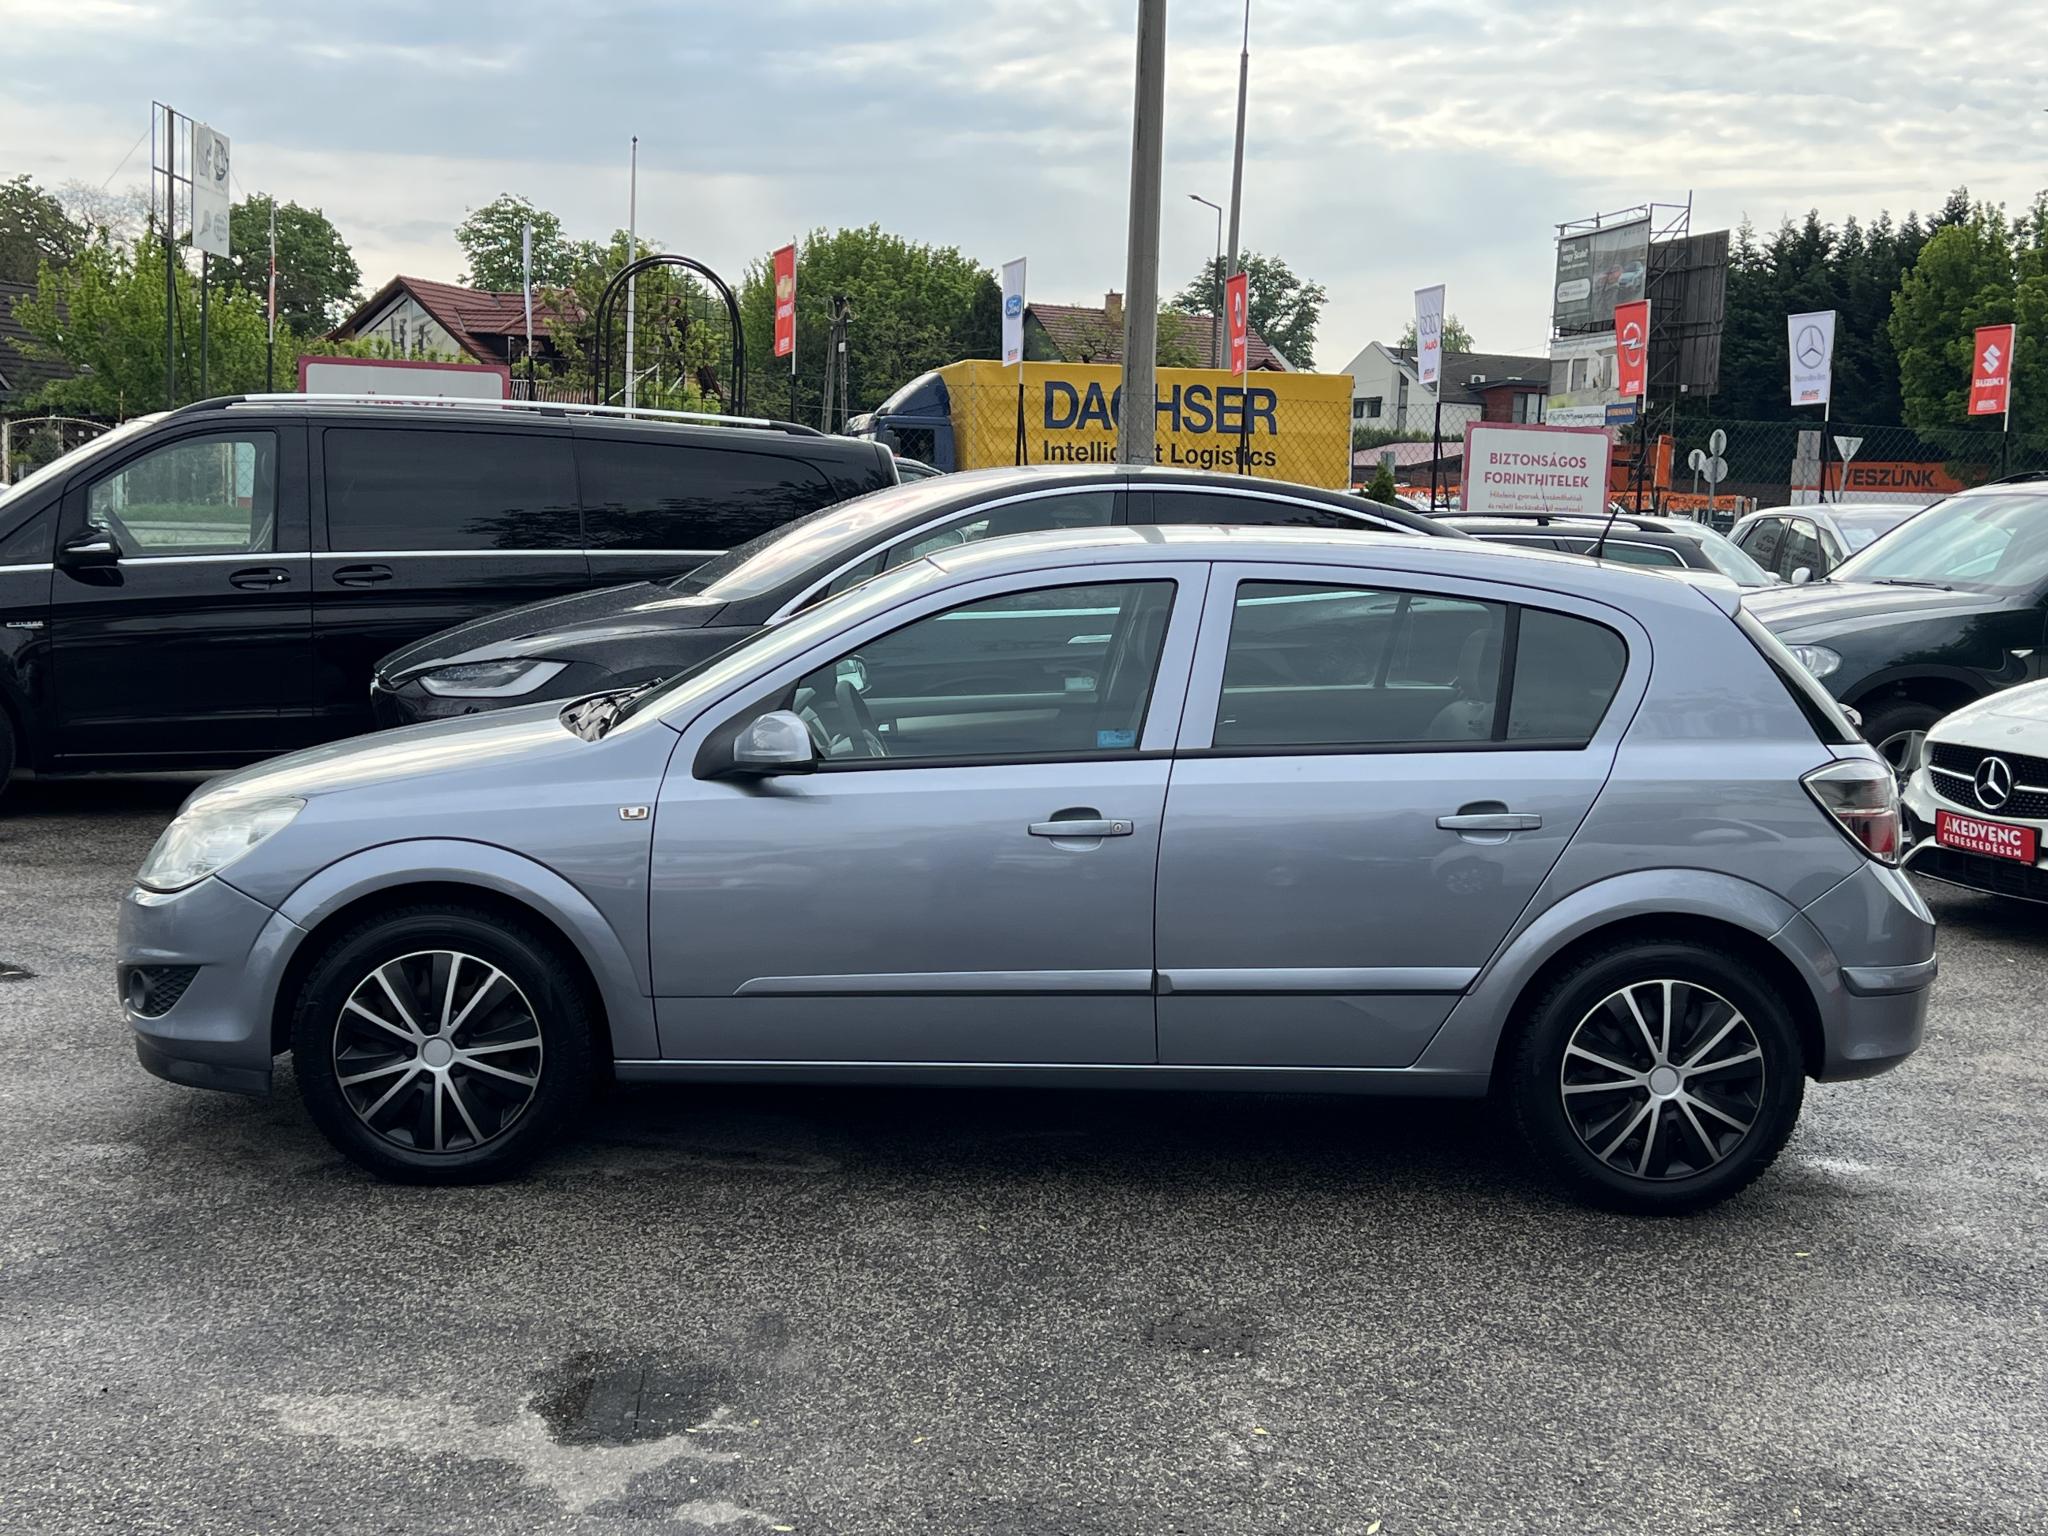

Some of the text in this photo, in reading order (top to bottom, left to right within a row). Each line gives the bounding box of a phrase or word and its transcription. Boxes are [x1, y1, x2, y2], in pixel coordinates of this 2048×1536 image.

[1043, 440, 1163, 465] Intellit
[1489, 452, 1587, 469] BIZTONSÁGOS
[1484, 472, 1589, 488] FORINTHITELEK
[1943, 832, 2021, 857] KERESKEDÉSEM
